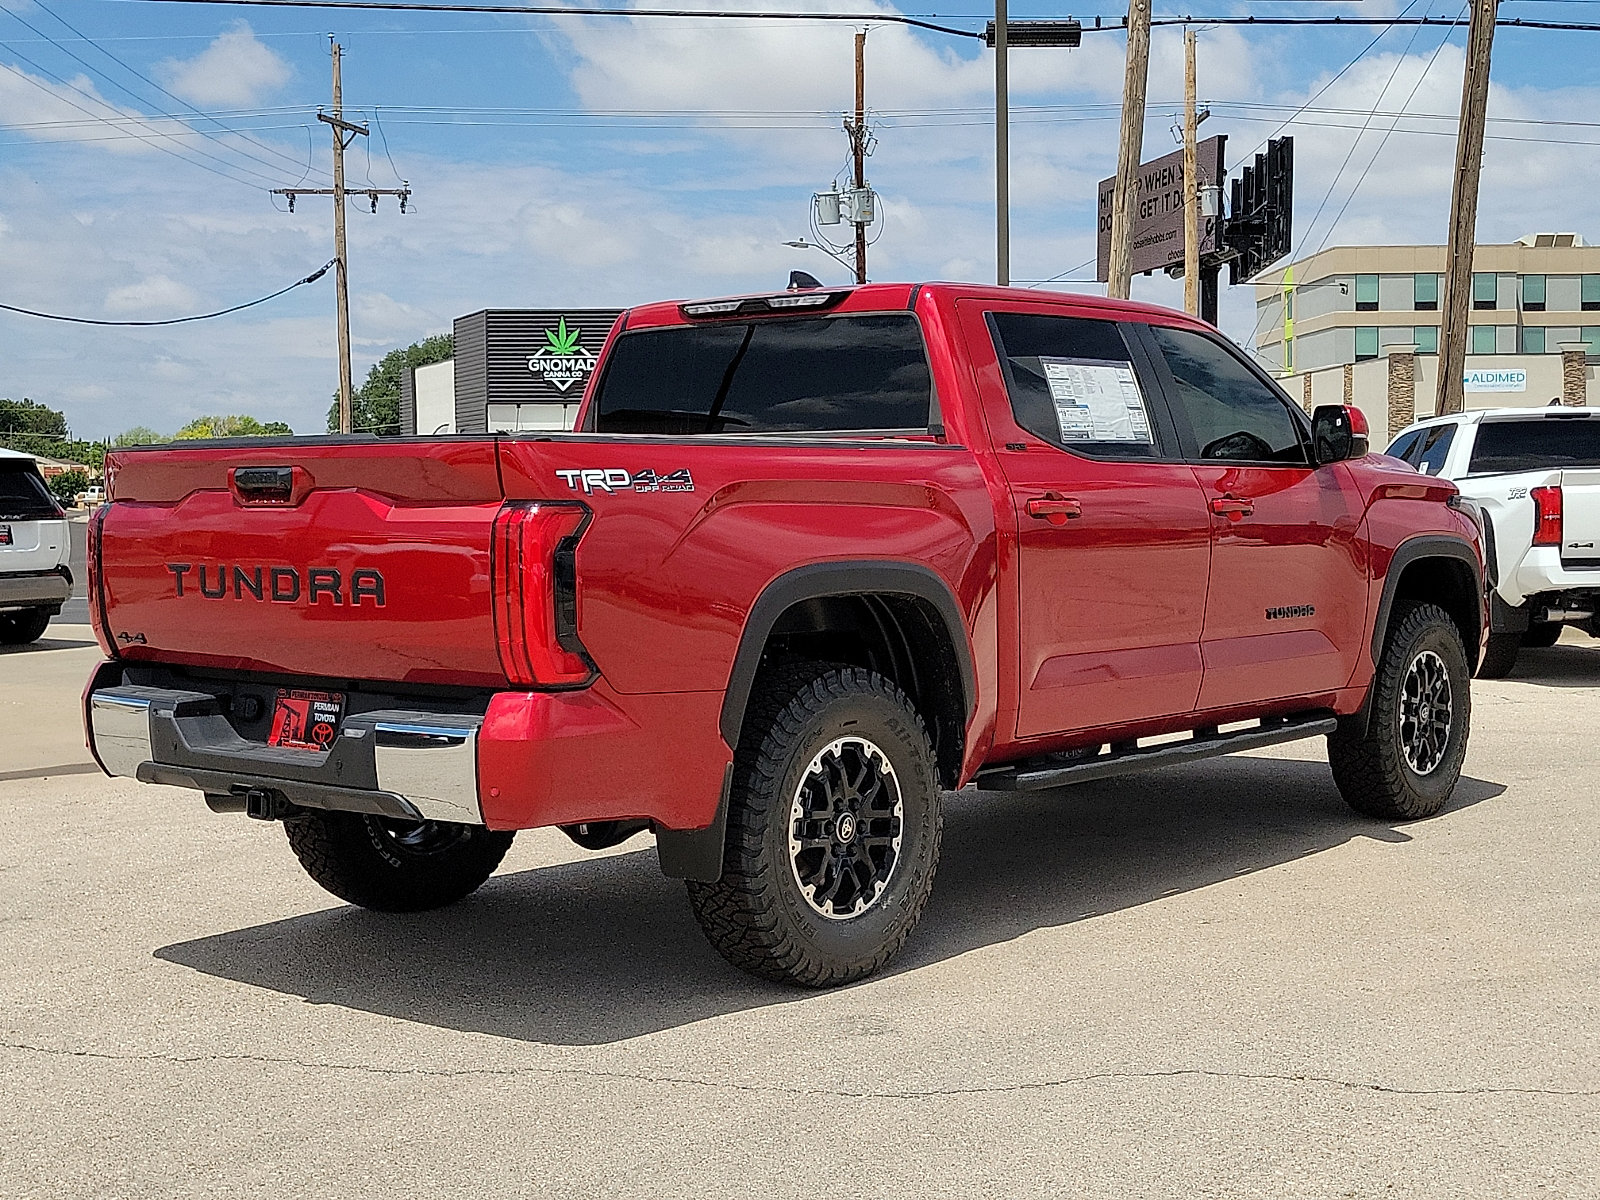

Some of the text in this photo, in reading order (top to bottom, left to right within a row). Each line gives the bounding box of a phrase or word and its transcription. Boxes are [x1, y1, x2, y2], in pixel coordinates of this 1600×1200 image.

[1145, 164, 1175, 194] WHEN
[1140, 196, 1158, 219] GET
[1161, 191, 1171, 213] IT
[528, 359, 597, 371] GNOMAD
[1471, 373, 1525, 383] ALDIMED
[555, 469, 634, 496] TRD
[635, 483, 695, 493] OFF ROAD
[165, 562, 386, 608] TUNDRA
[313, 701, 340, 713] PERMIAN
[313, 712, 336, 723] TOYOTA
